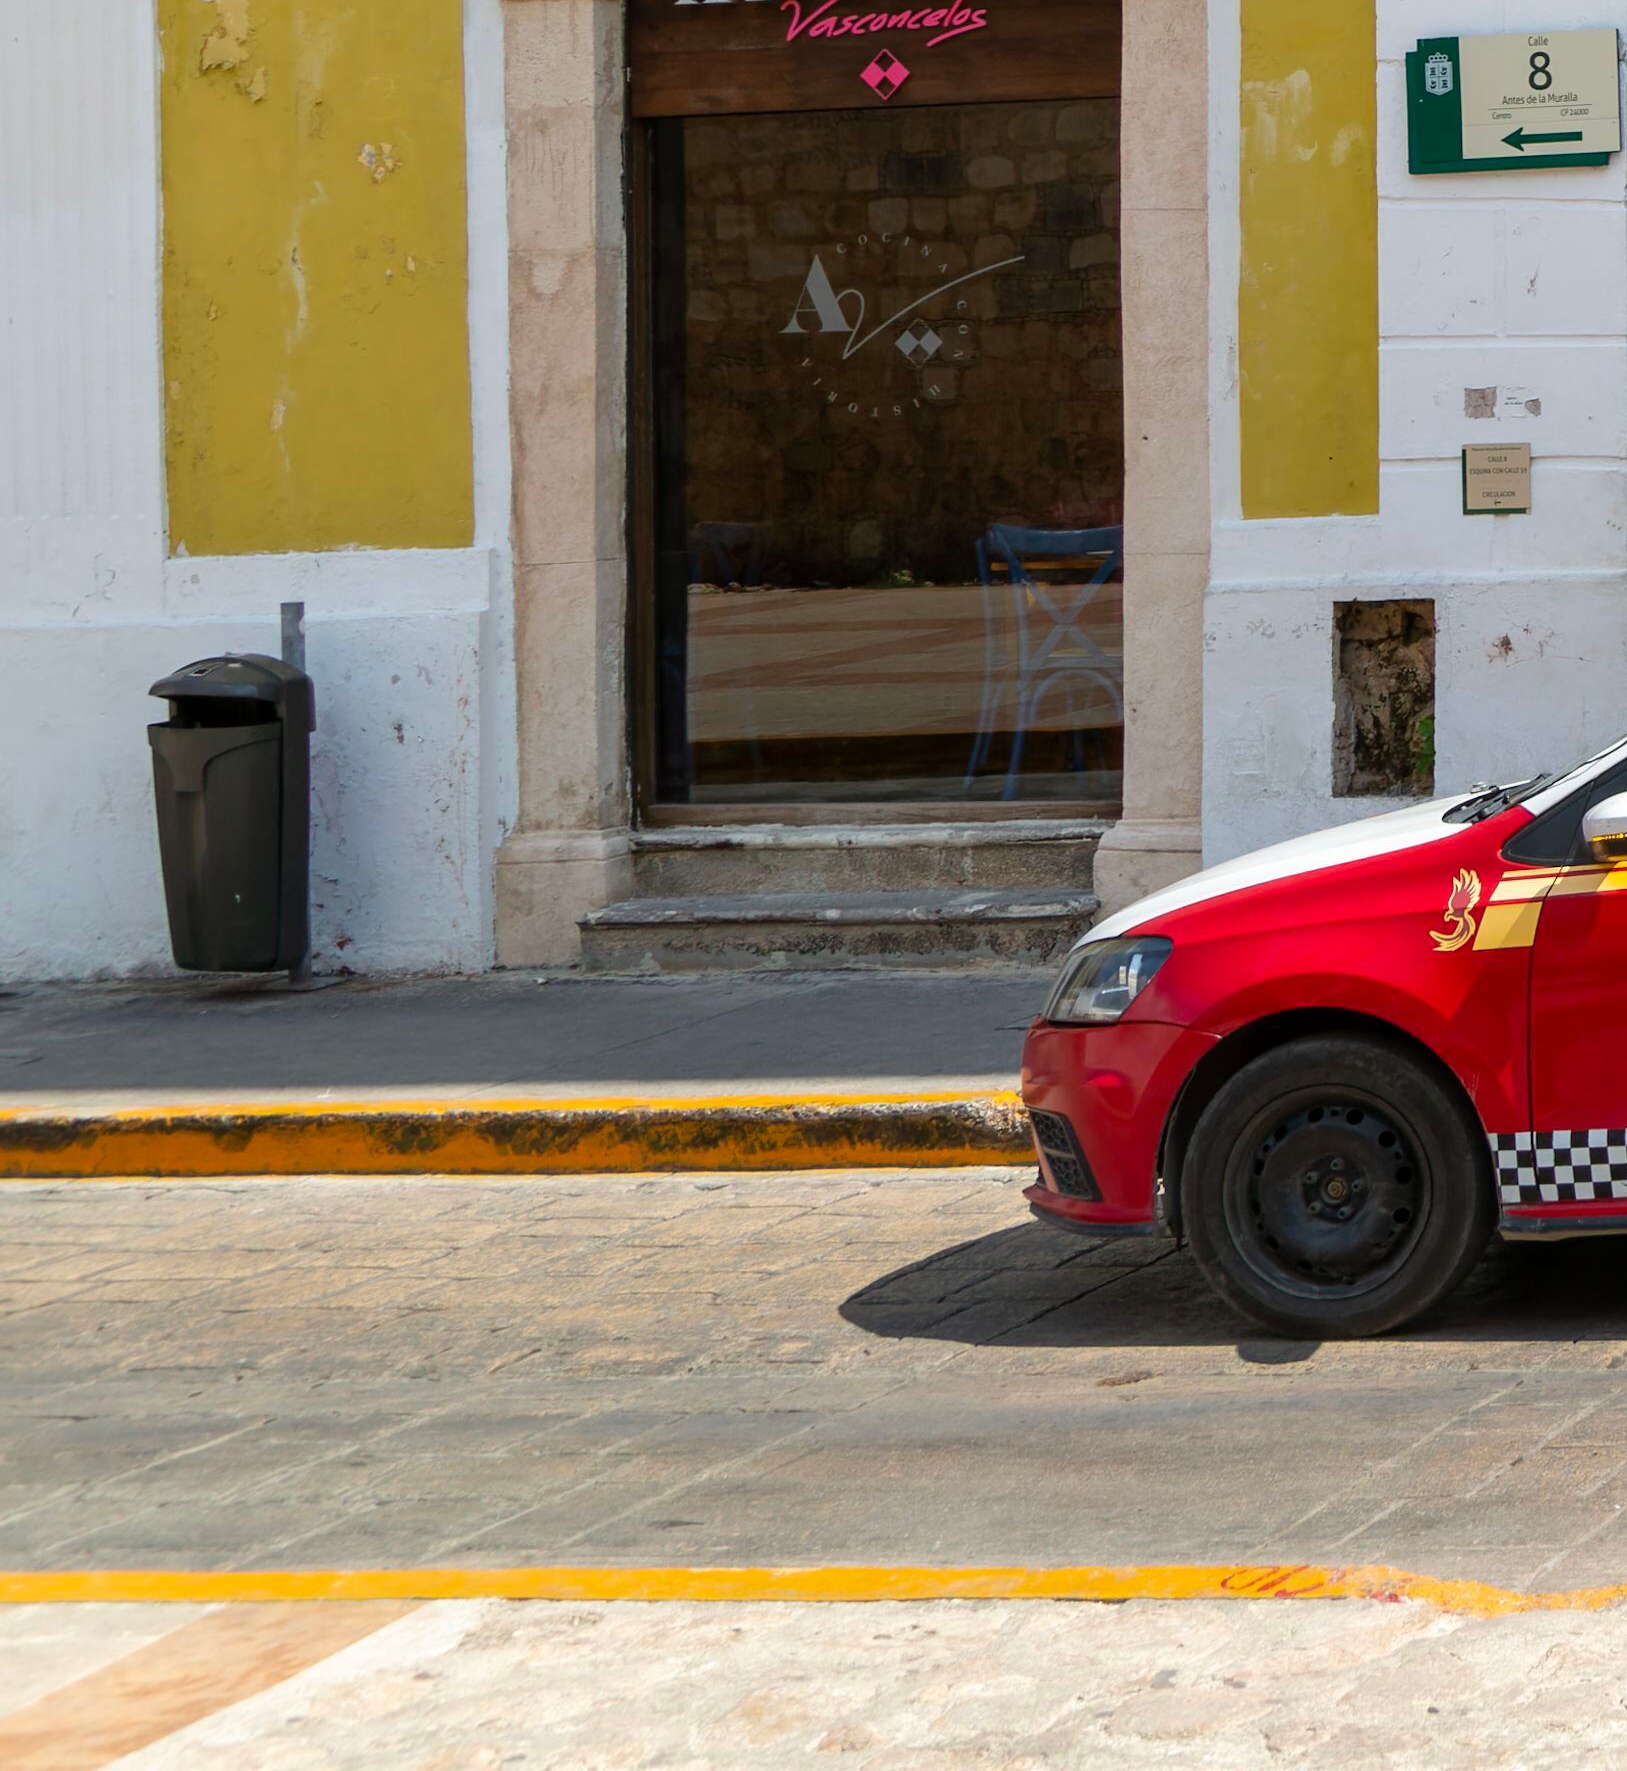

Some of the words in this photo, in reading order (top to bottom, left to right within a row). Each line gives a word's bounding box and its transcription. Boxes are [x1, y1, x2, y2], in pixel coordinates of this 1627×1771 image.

[1528, 36, 1549, 47] Calle
[1528, 51, 1553, 91] 8
[1502, 95, 1525, 105] Antes
[1526, 94, 1537, 104] de
[1539, 94, 1546, 103] la
[1548, 92, 1578, 103] Muralla
